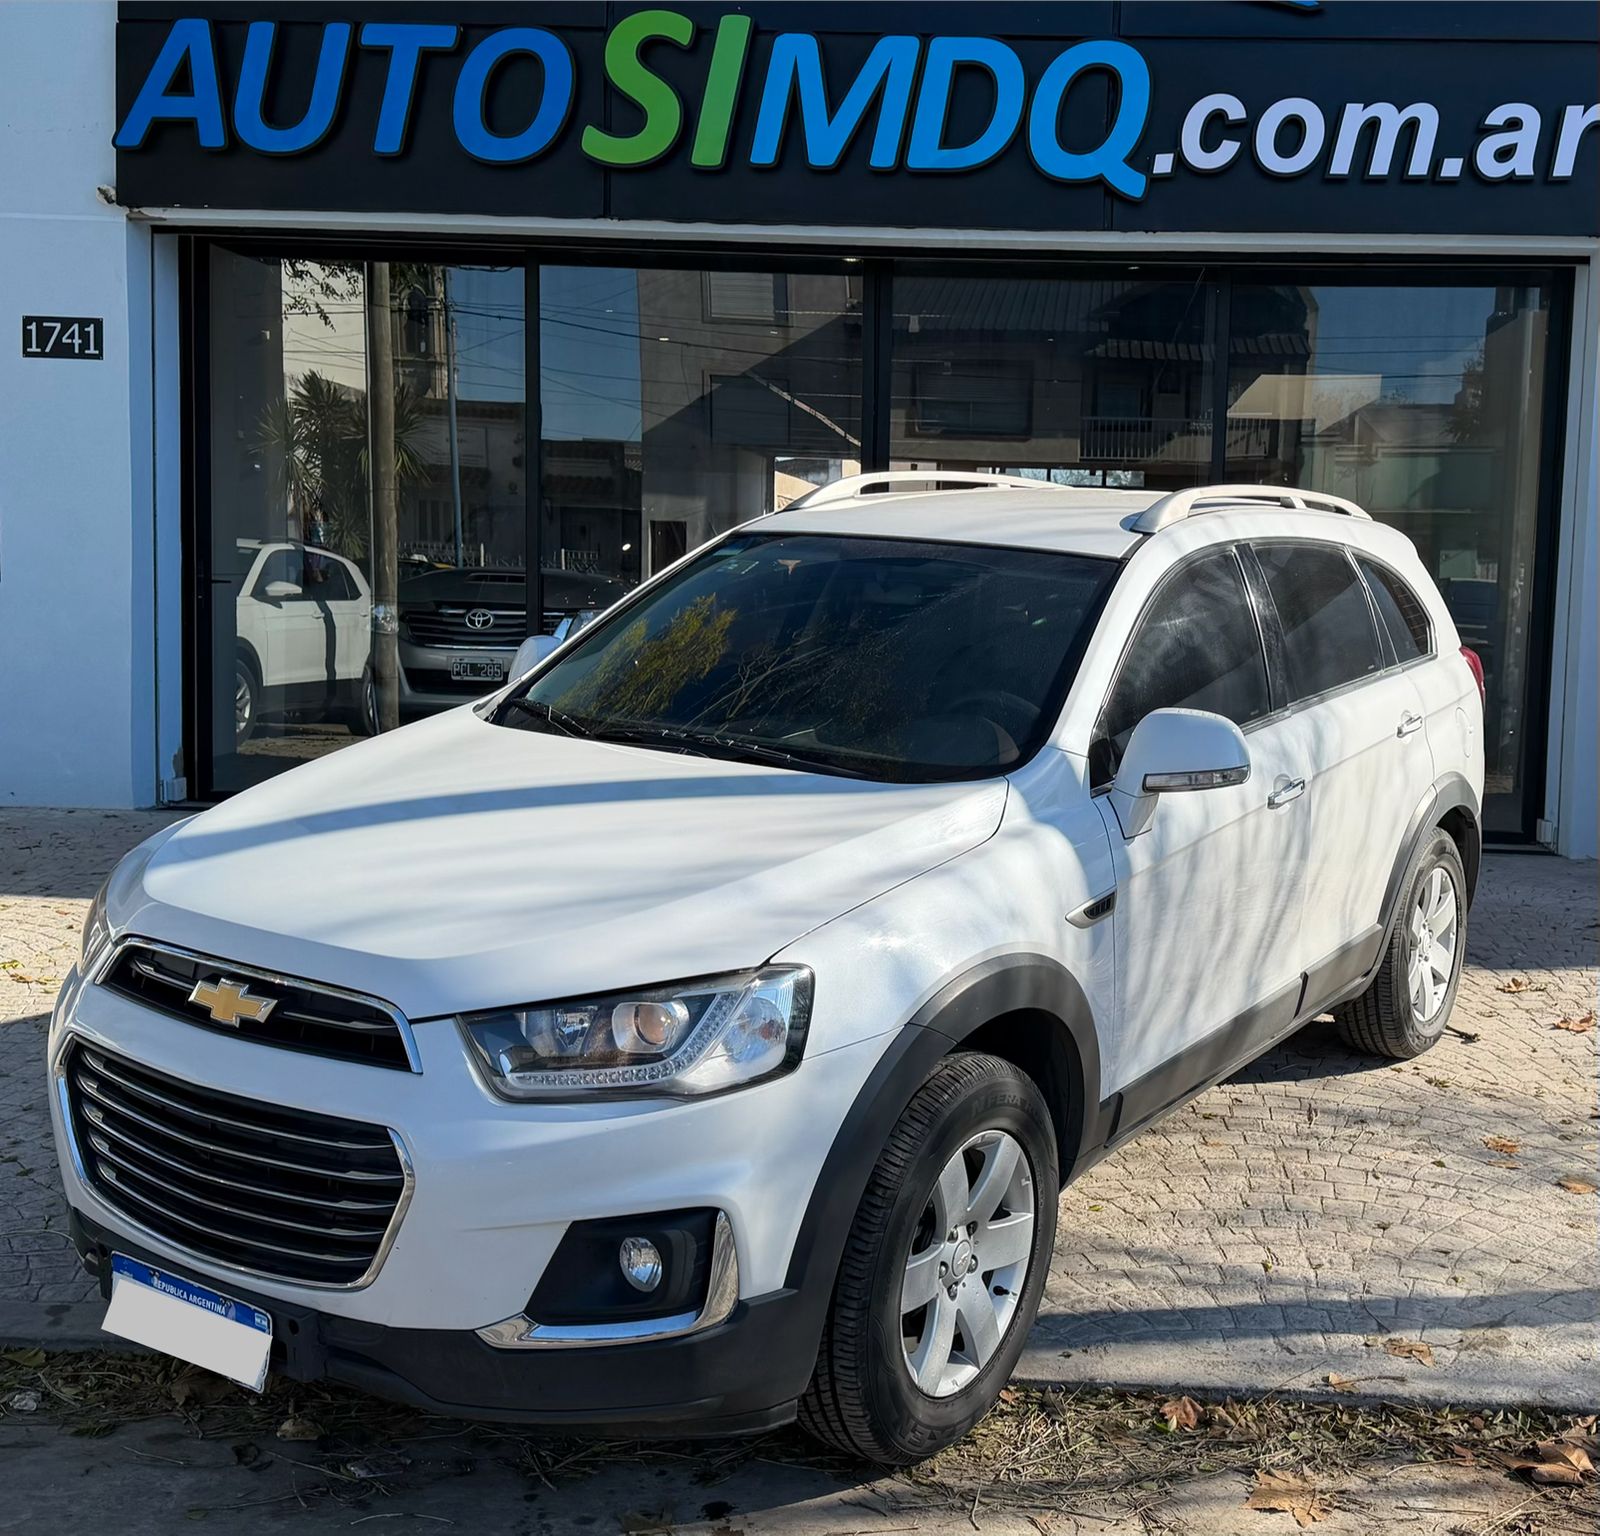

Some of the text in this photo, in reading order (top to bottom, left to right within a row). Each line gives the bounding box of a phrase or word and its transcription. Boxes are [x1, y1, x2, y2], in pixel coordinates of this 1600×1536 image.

[26, 321, 100, 355] 1741
[480, 664, 501, 677] 285
[189, 1294, 226, 1316] ARGENTINA
